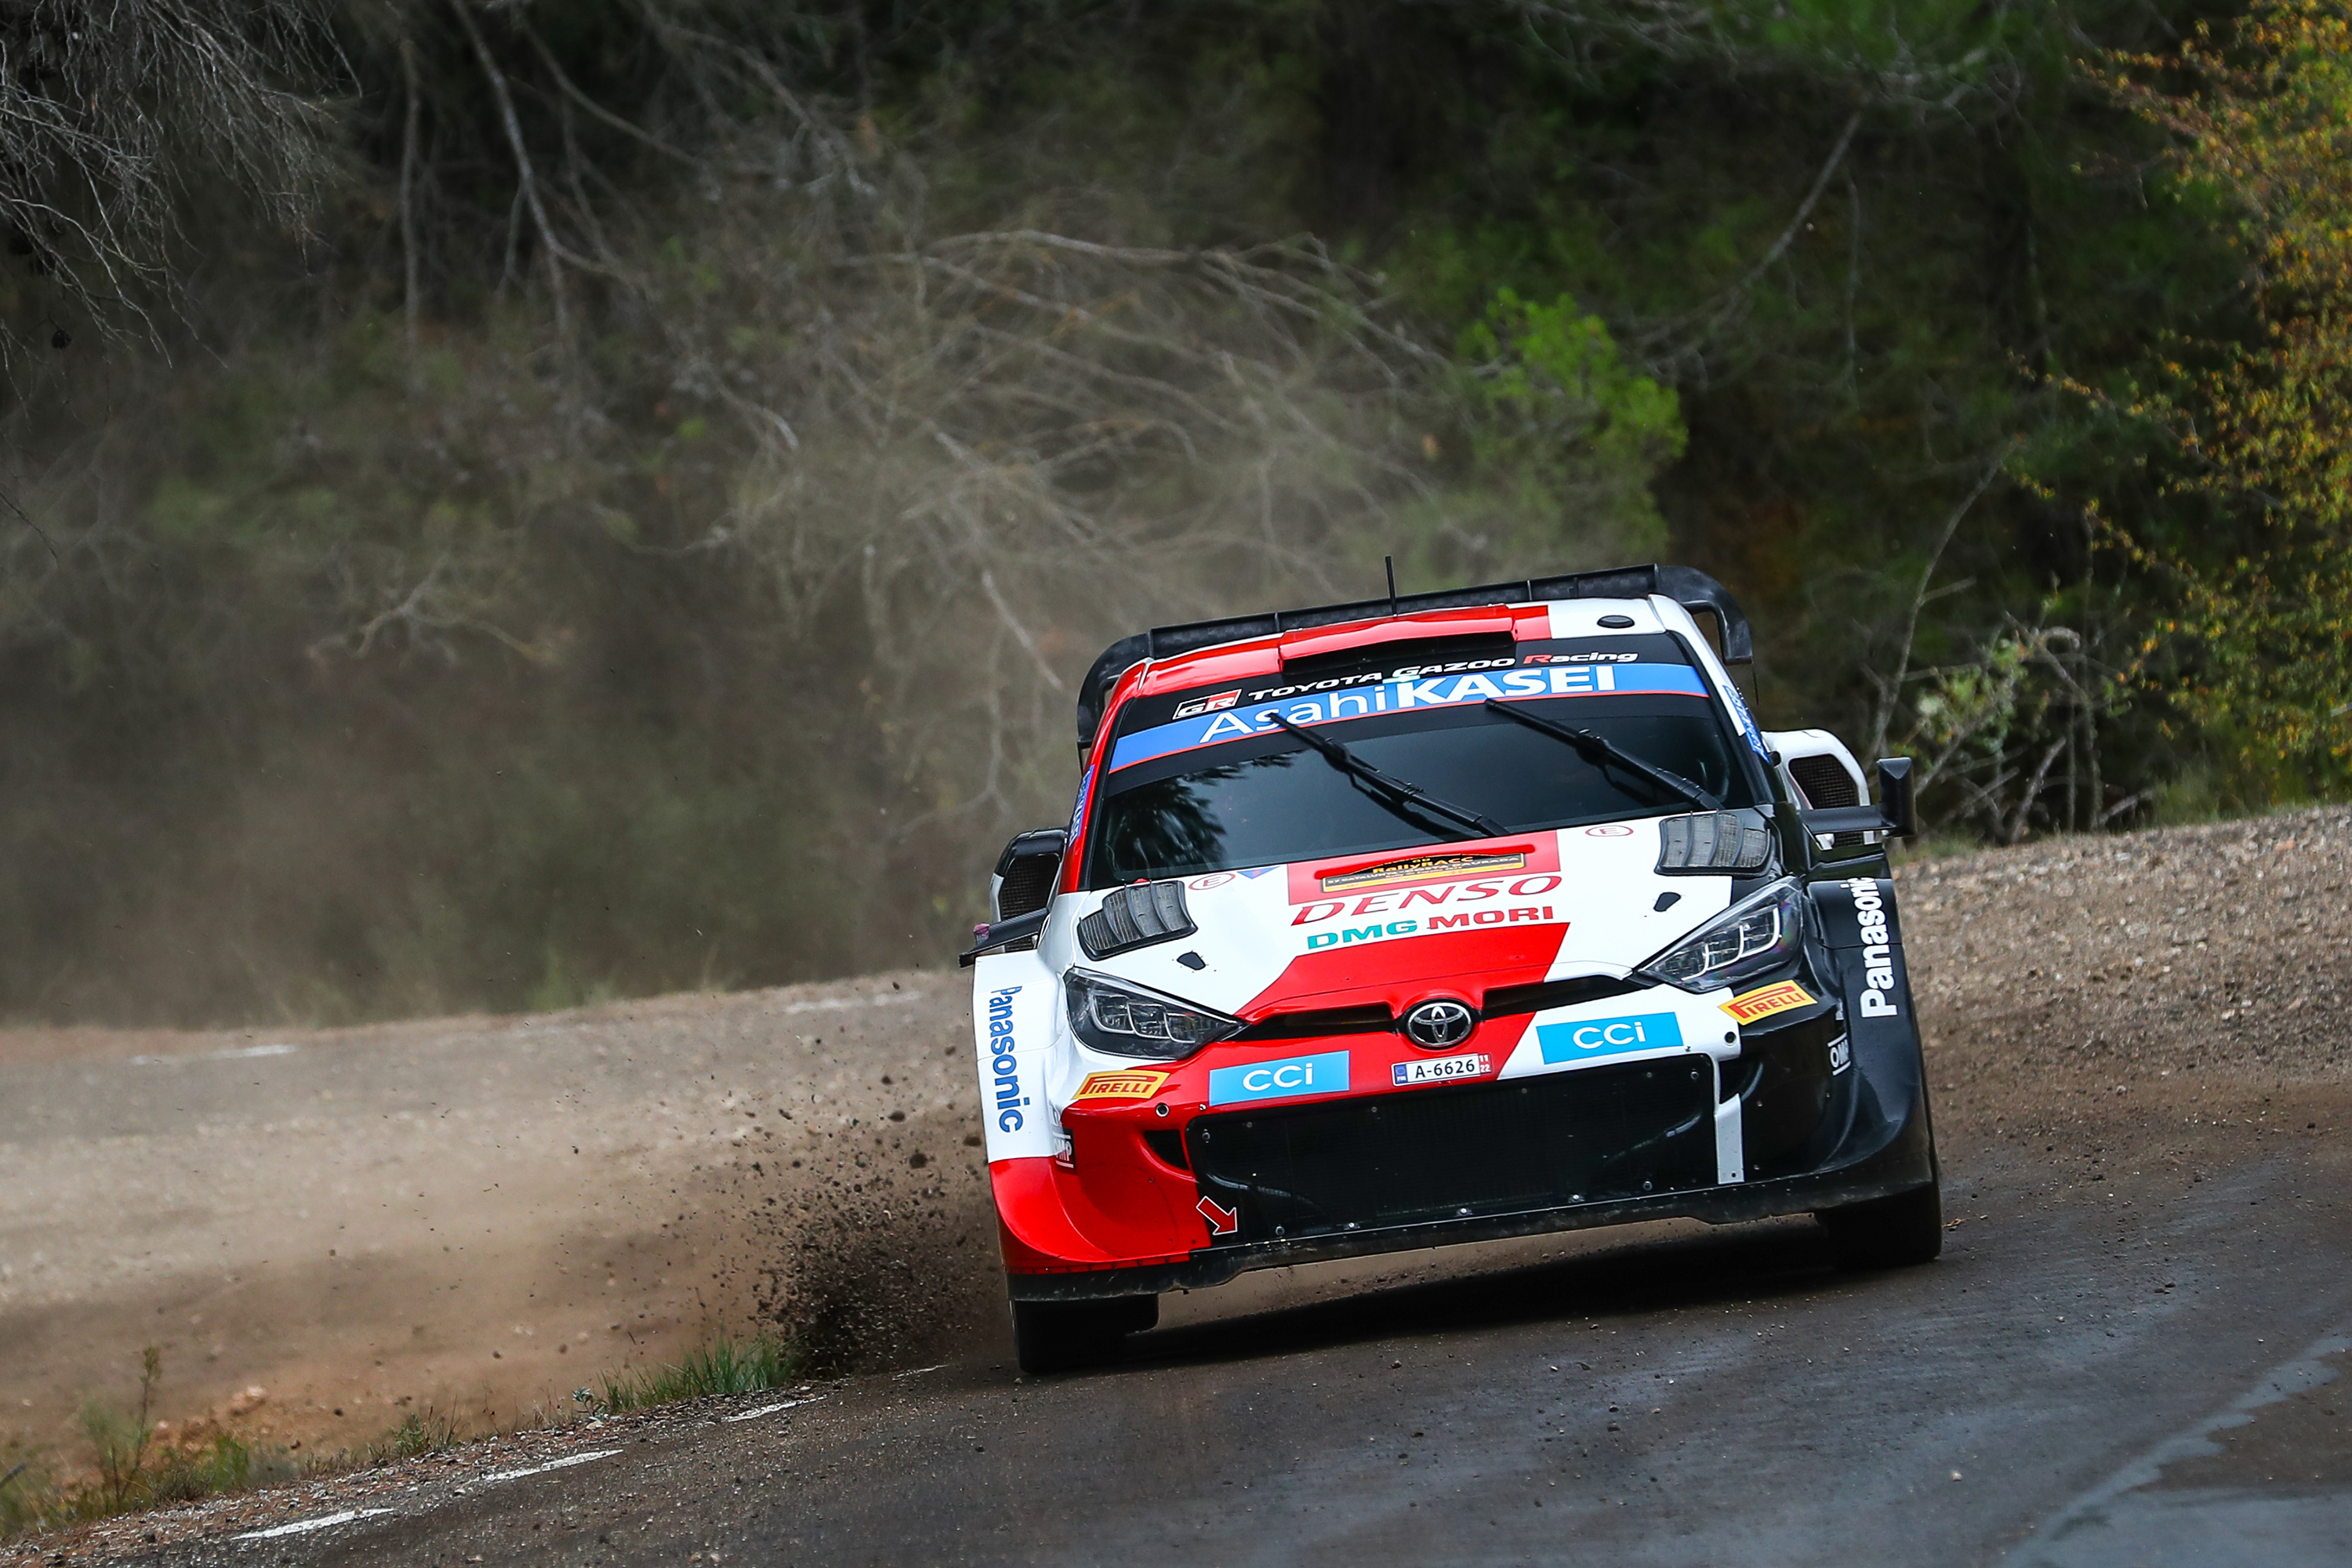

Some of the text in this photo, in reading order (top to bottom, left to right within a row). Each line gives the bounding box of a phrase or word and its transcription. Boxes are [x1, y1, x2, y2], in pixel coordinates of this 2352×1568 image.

[1248, 673, 1382, 700] TOYOTA
[1392, 658, 1515, 678] GAZOO
[1523, 652, 1639, 664] Racing
[1372, 857, 1474, 873] RallyRACC
[1291, 876, 1563, 927] DENSO
[1307, 906, 1554, 950] DMG MORI
[1840, 877, 1898, 1018] Panasonic
[1728, 985, 1806, 1019] PIRELLI
[989, 985, 1030, 1134] Panasonic
[1415, 1059, 1475, 1079] A-6626
[1479, 1054, 1489, 1062] 11
[1480, 1063, 1491, 1073] 22
[1079, 1073, 1159, 1095] PIRELLI
